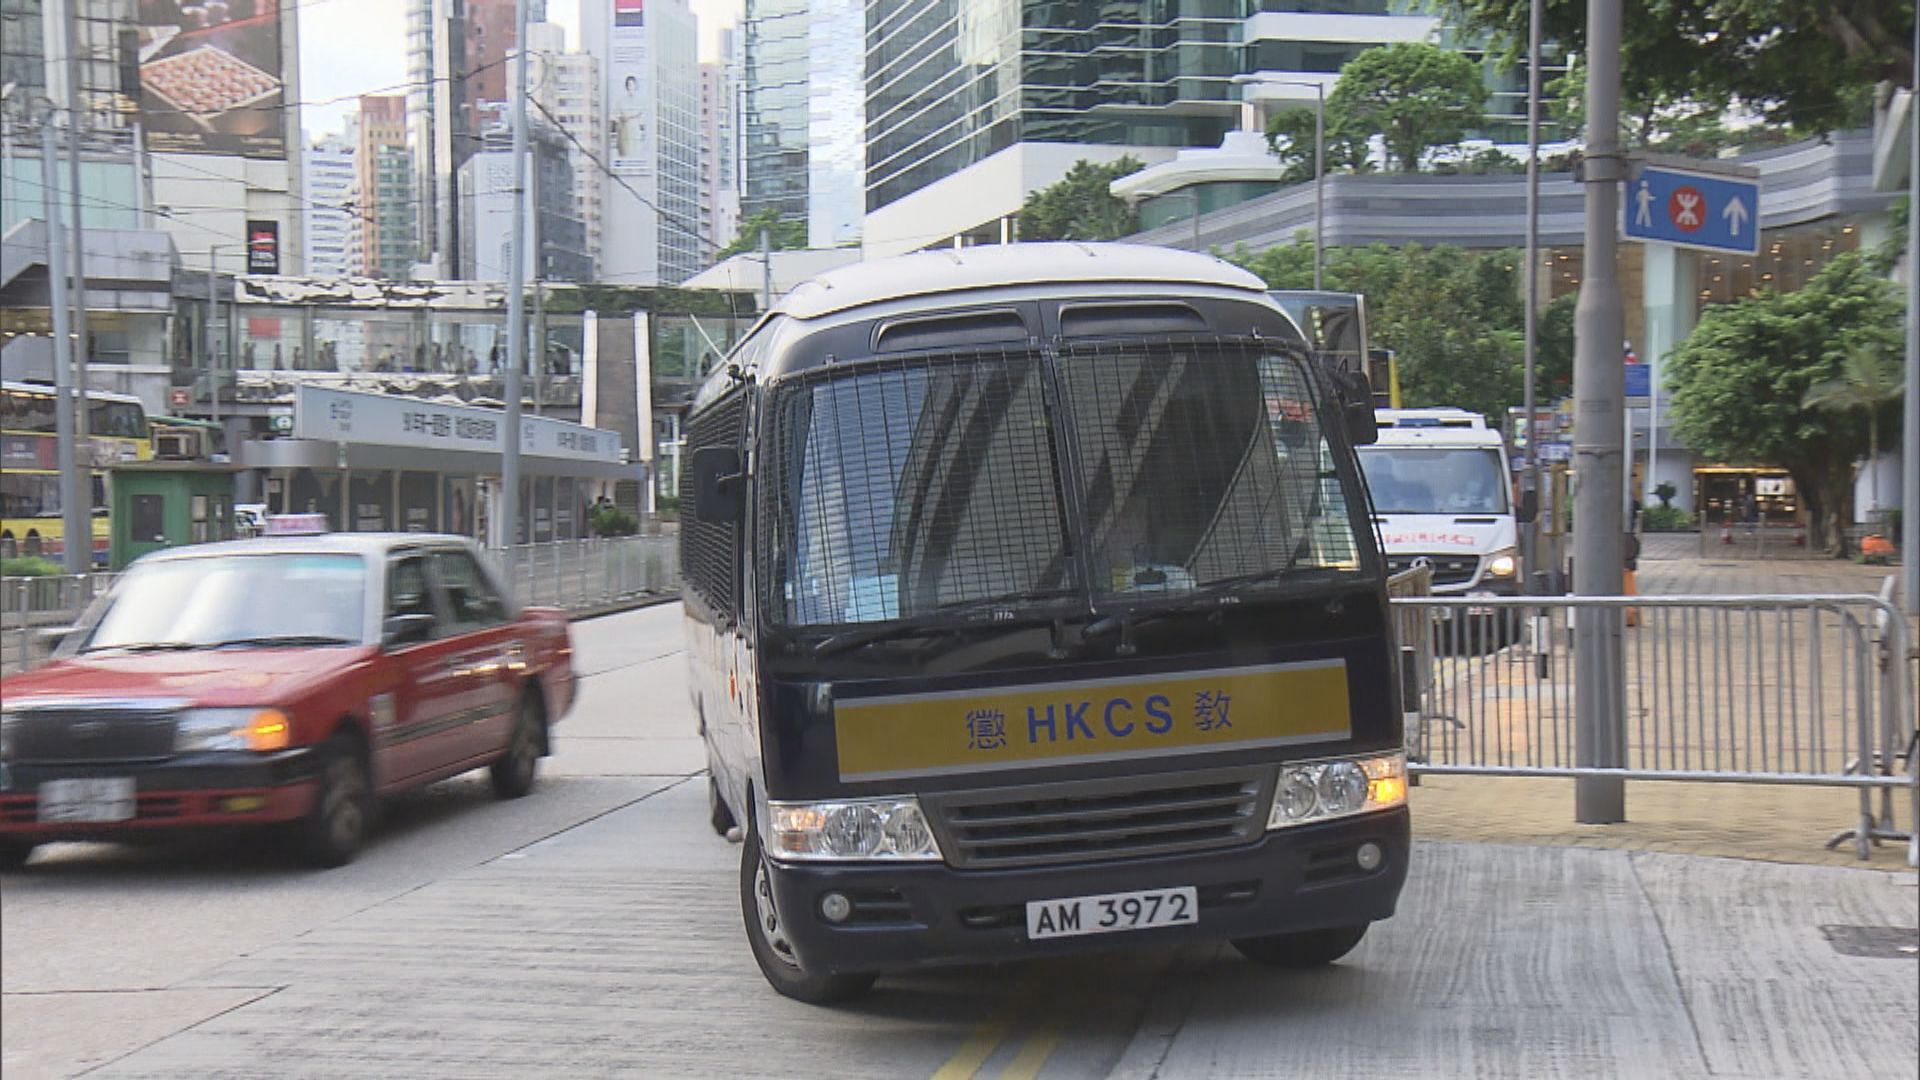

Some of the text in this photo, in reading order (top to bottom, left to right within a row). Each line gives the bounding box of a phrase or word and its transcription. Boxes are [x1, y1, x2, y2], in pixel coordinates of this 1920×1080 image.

[966, 708, 1007, 749] 懲
[1027, 695, 1173, 743] HKCS
[1036, 894, 1190, 934] AM 3972
